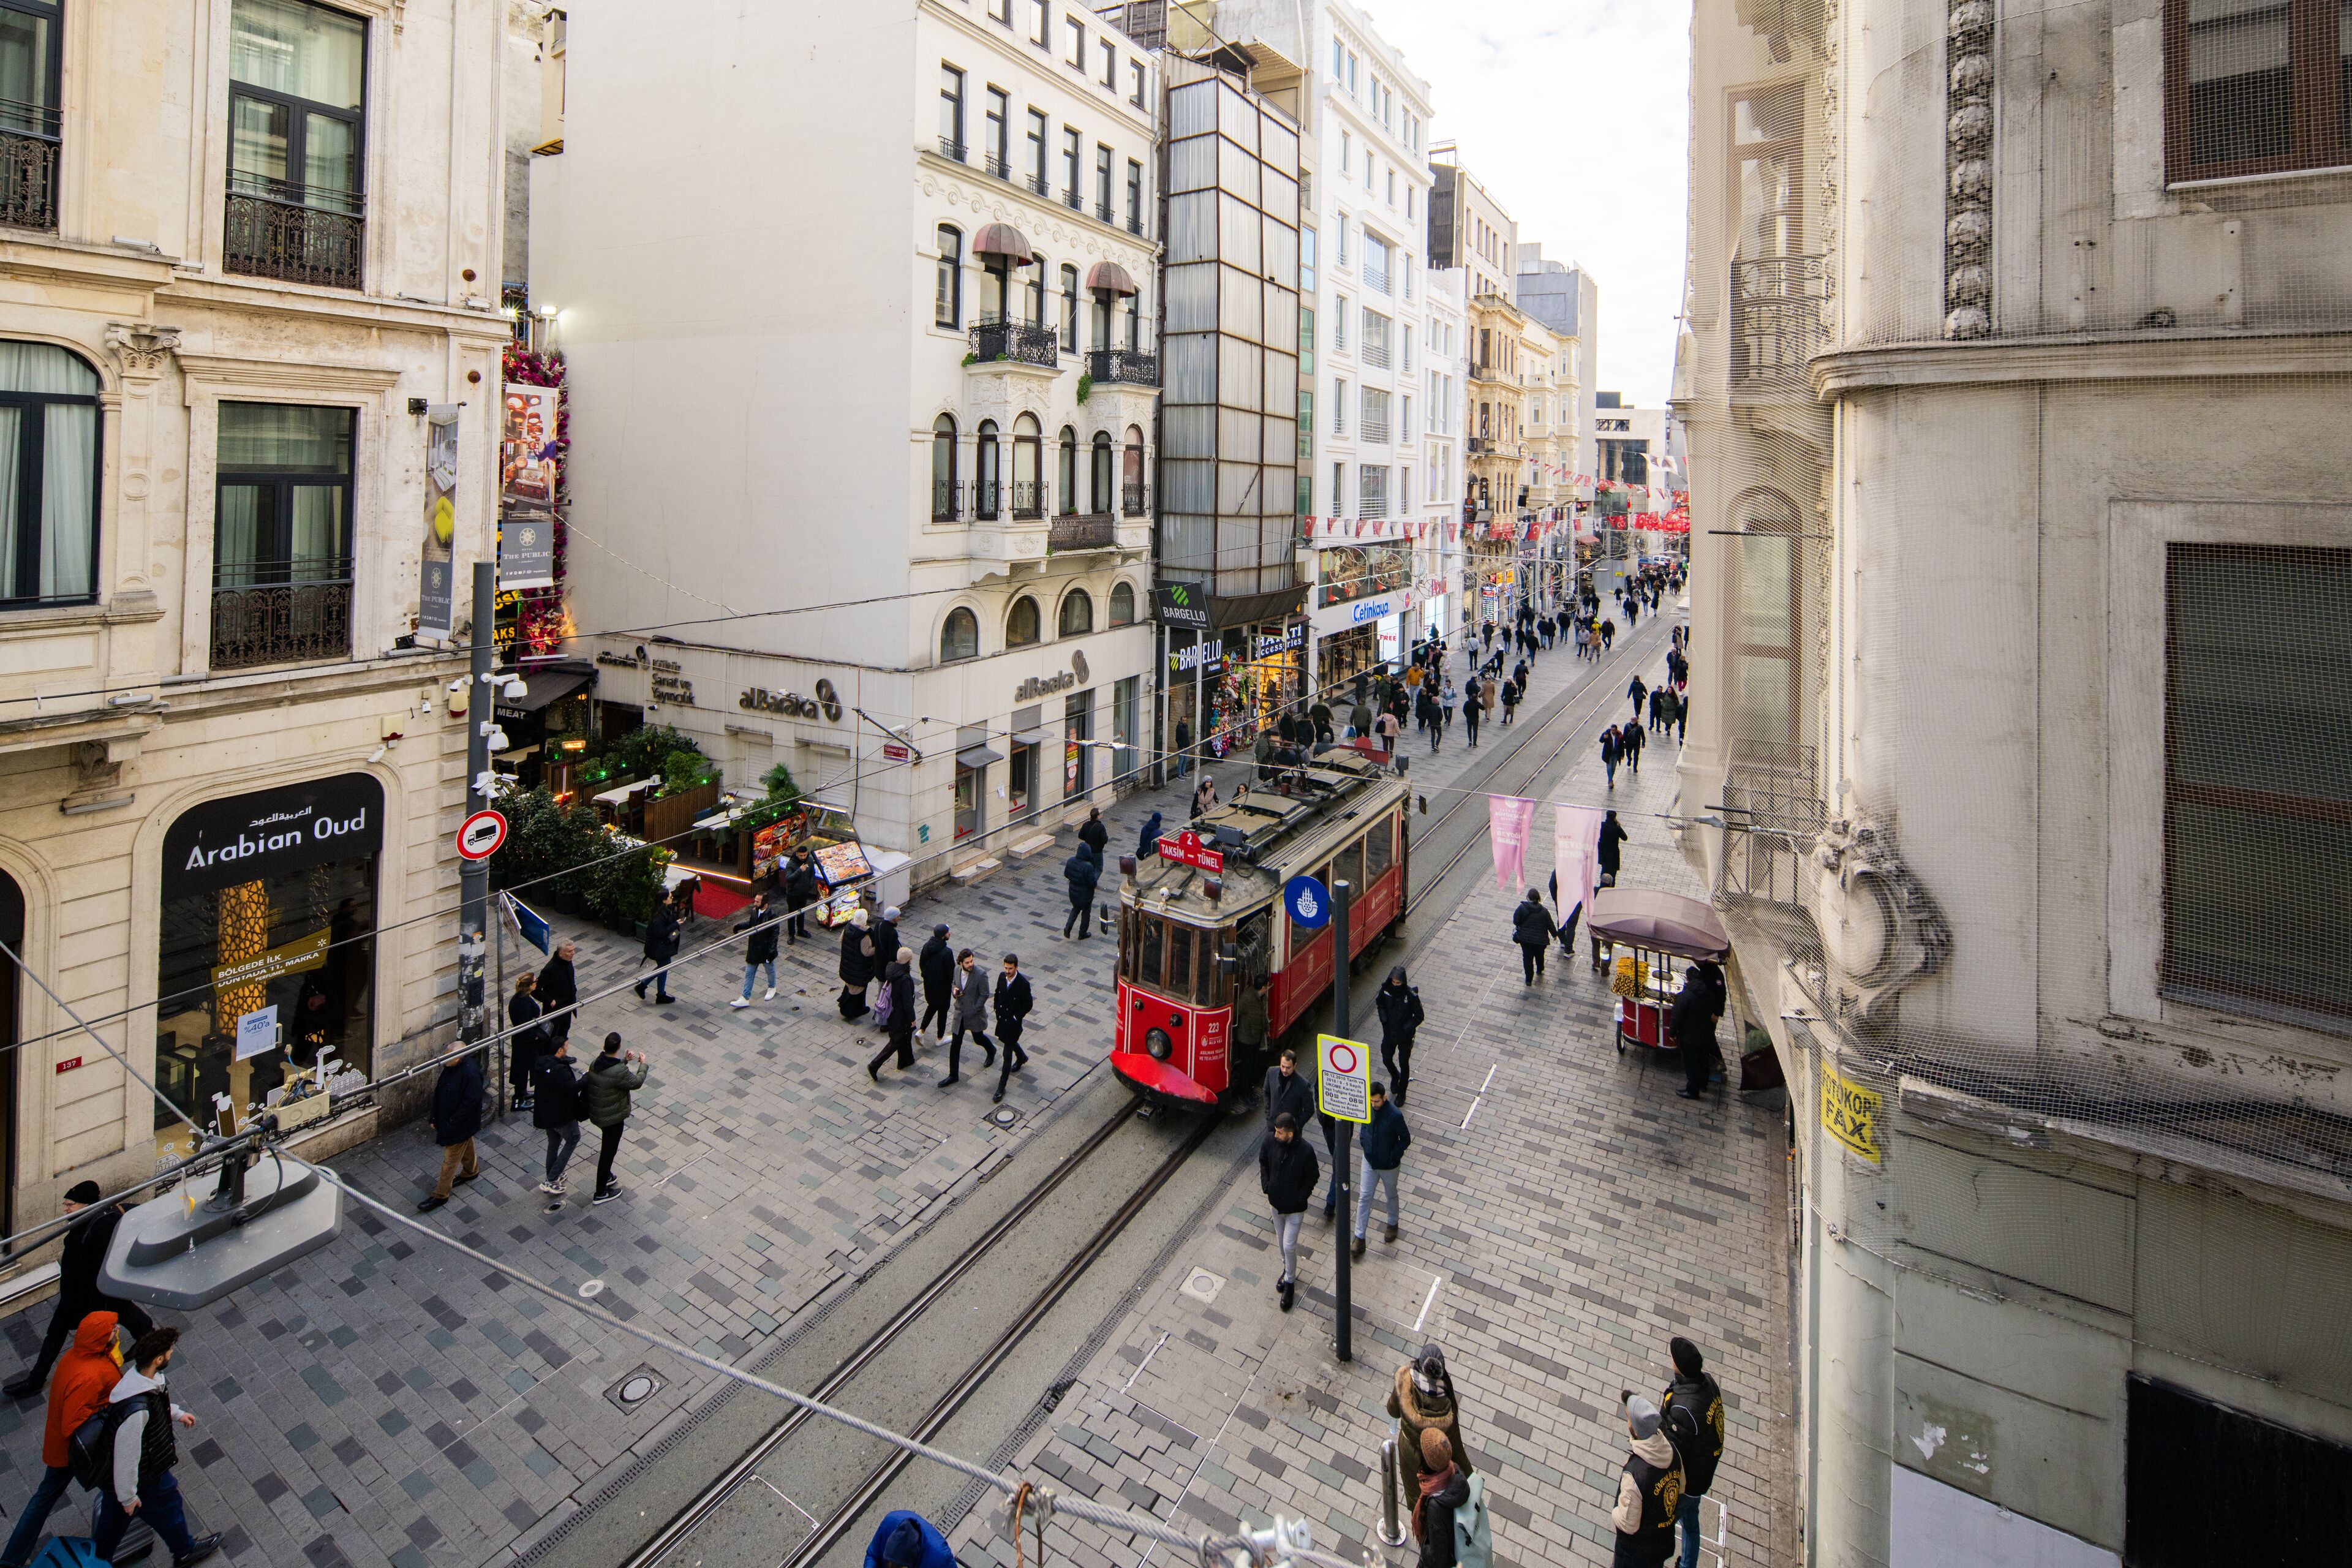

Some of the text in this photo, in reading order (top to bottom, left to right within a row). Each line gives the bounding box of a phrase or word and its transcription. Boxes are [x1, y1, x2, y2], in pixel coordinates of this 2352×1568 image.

[431, 595, 451, 605] PUBLIC
[1163, 606, 1206, 622] BARGELLO
[1179, 639, 1221, 671] BARELLO
[1255, 638, 1302, 658] accessries
[652, 673, 693, 690] Sanat ve
[1014, 670, 1075, 703] alBaraka
[497, 707, 526, 719] MEAT
[185, 807, 366, 871] Arabian Oud
[1187, 833, 1193, 846] 2
[1161, 843, 1185, 859] TAKSİM
[1197, 853, 1219, 869] TÜNEL
[218, 954, 282, 979] BÖLGEDE İLK
[255, 969, 285, 982] PERFUMER
[1208, 1022, 1219, 1033] 223
[62, 1060, 77, 1070] 137
[1324, 1072, 1346, 1080] 30.12.2010
[1826, 1097, 1868, 1144] FAX
[1654, 1471, 1673, 1496] GÜVENLİK
